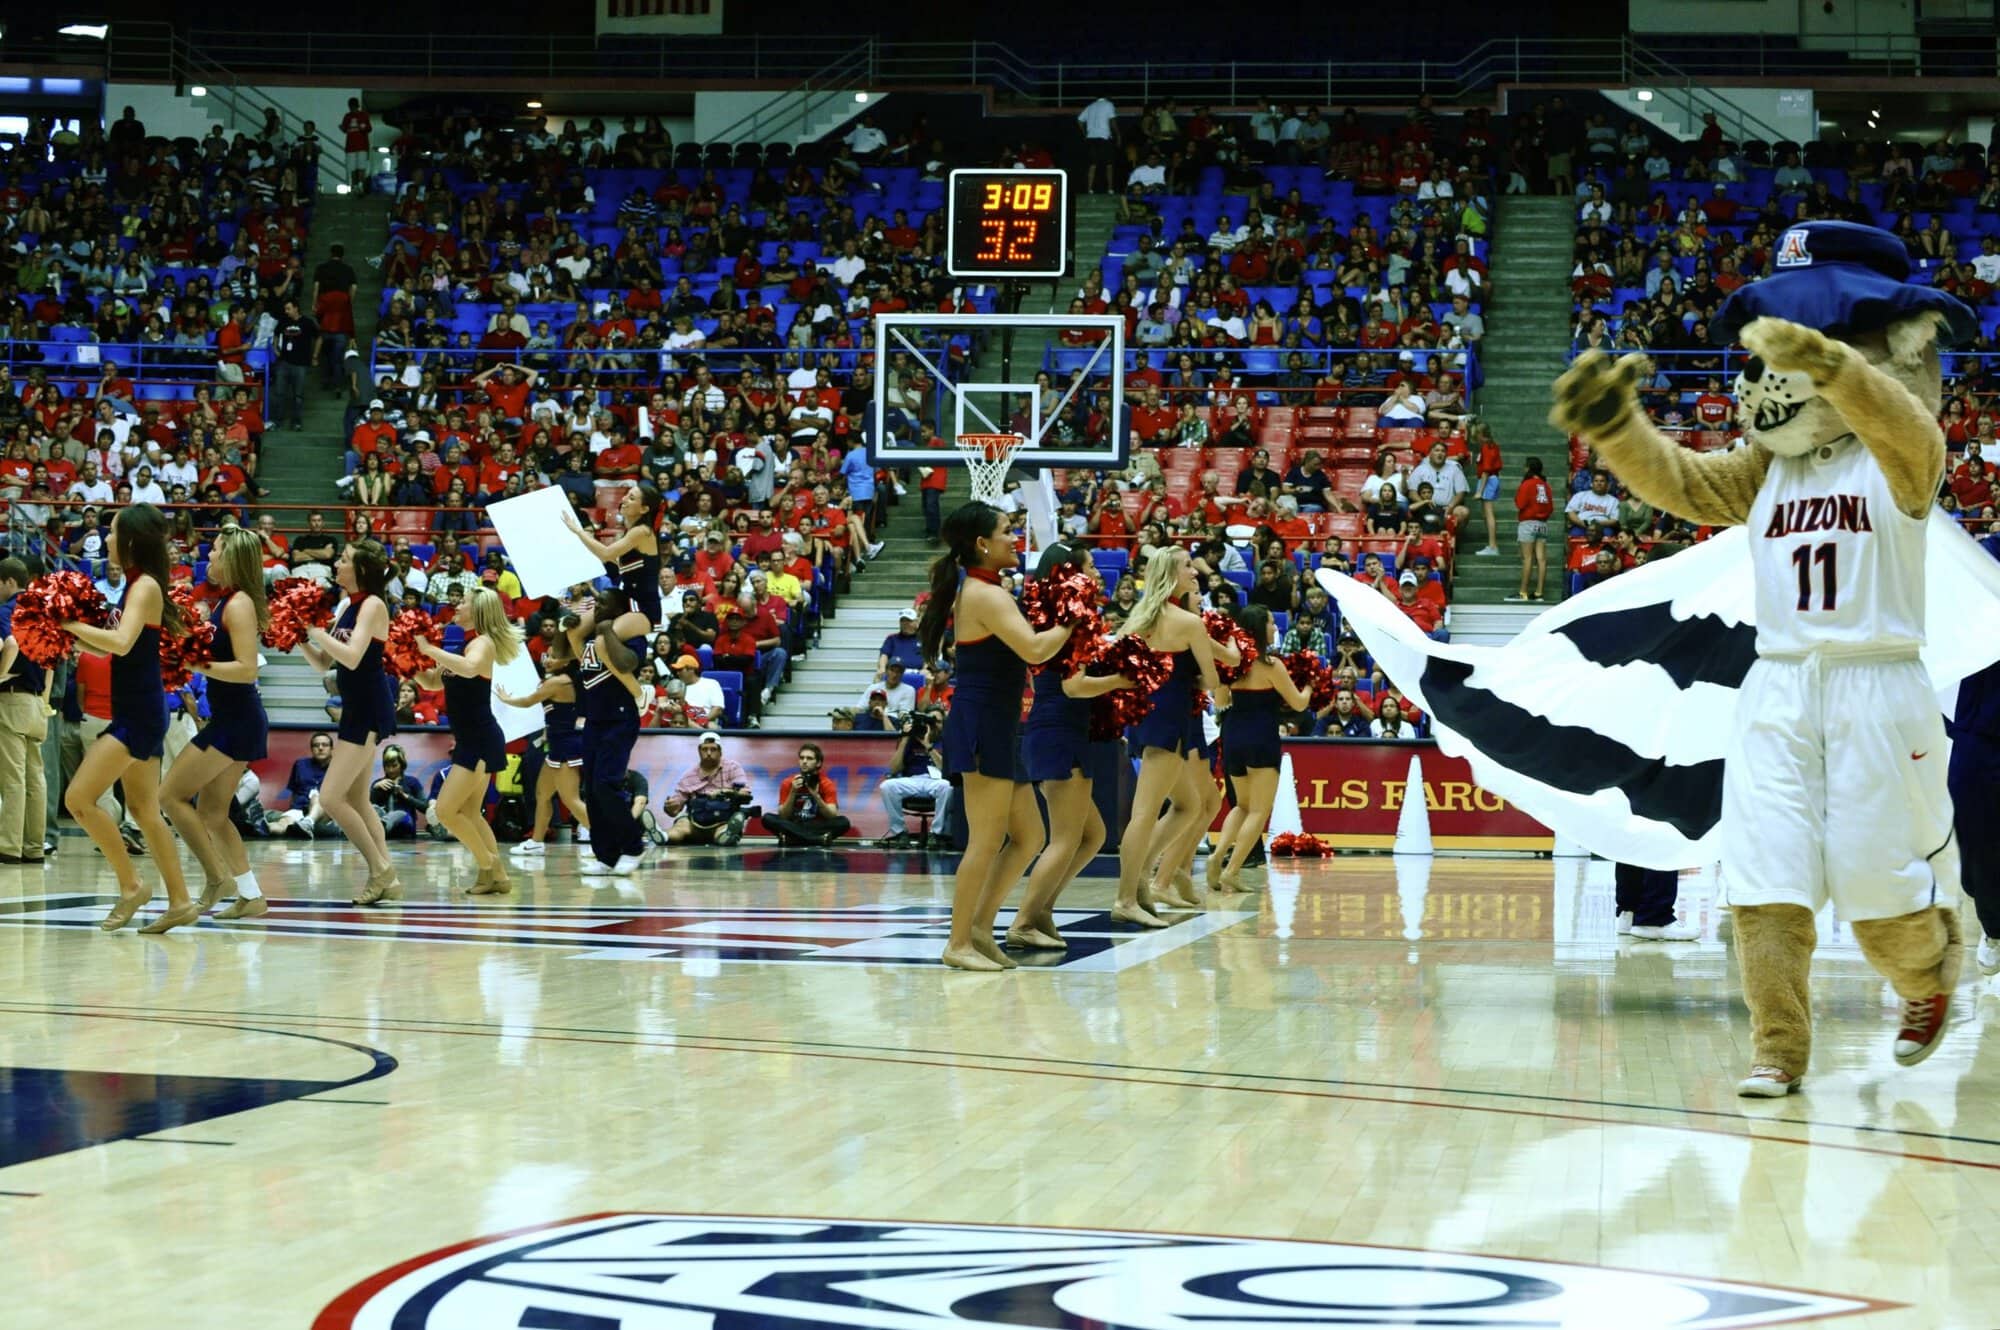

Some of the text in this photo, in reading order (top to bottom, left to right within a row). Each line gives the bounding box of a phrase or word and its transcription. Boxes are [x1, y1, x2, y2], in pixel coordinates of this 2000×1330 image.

[983, 184, 1052, 210] 3:09
[977, 220, 1037, 260] 32
[1776, 229, 1813, 267] A
[1792, 542, 1837, 611] 11
[1380, 781, 1505, 812] FARG
